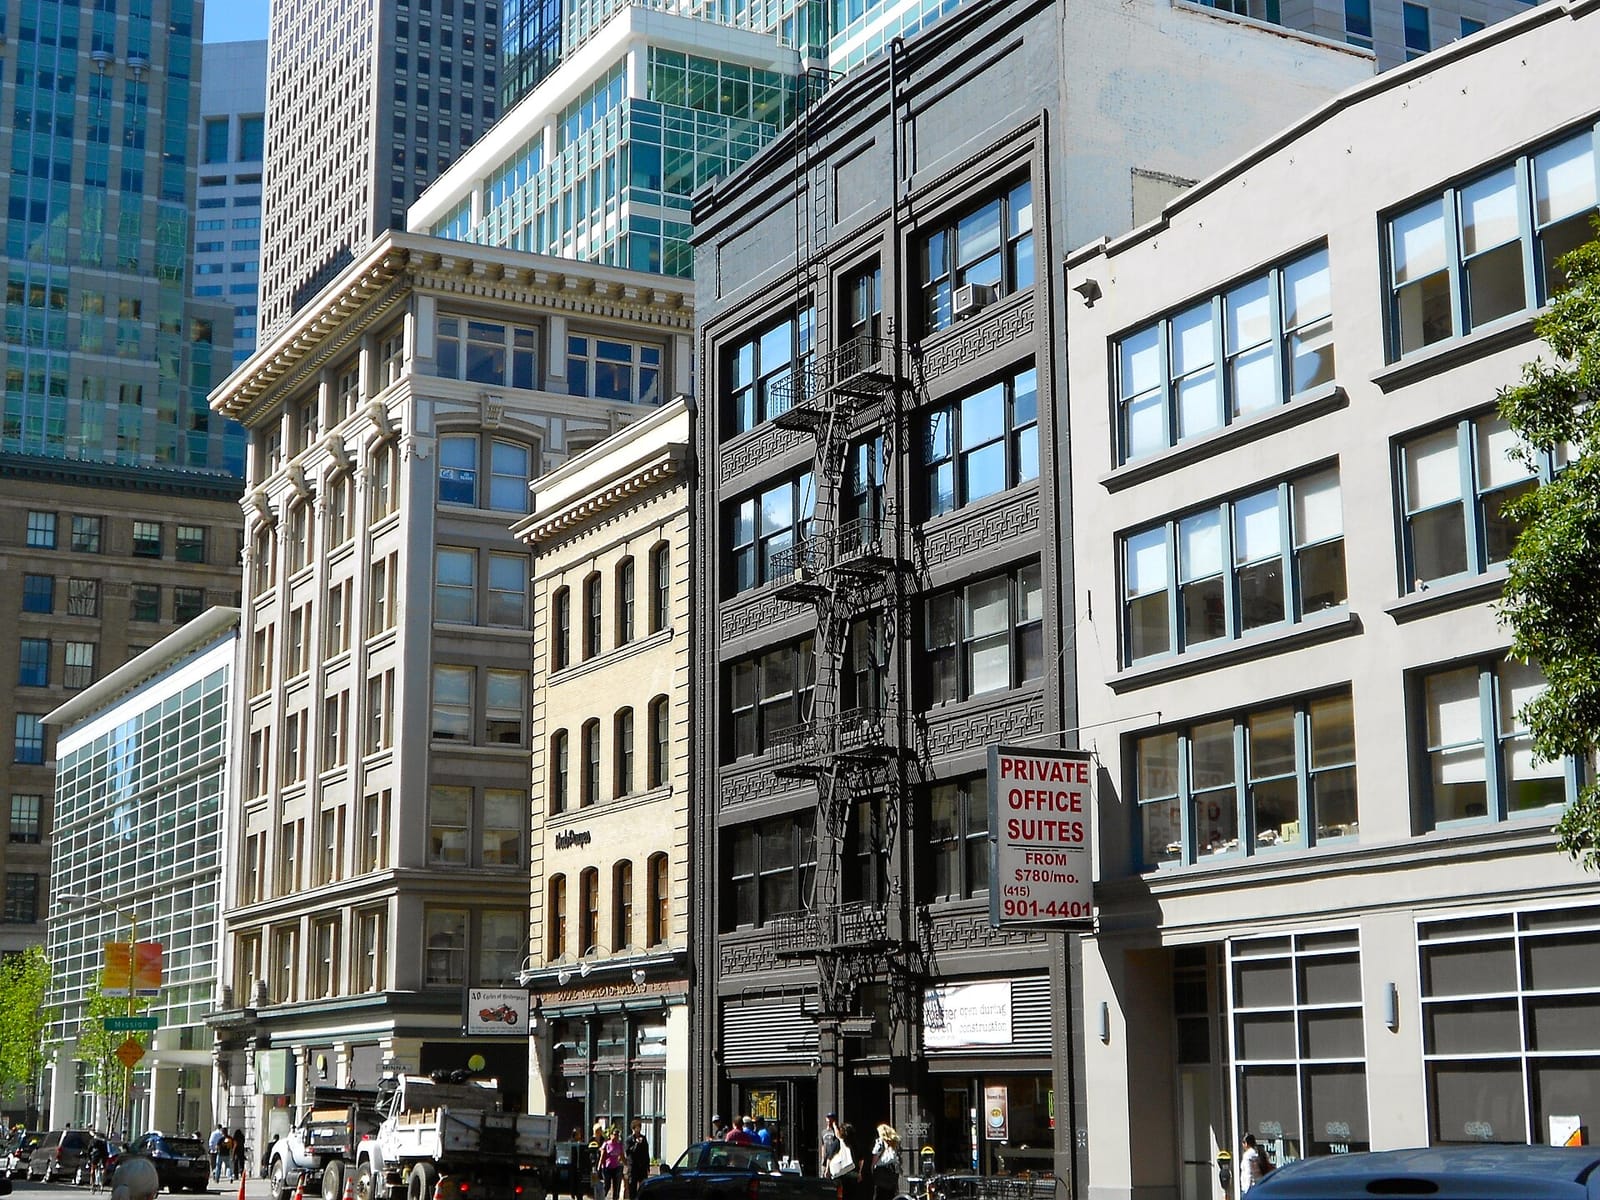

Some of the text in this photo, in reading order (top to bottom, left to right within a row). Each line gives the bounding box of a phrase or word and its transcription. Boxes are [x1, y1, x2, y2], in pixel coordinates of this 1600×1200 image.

[1001, 758, 1088, 784] PRIVATE
[1008, 788, 1082, 813] OFFICE
[1007, 818, 1084, 843] SUITES
[1025, 852, 1067, 866] FROM
[1015, 868, 1079, 884] $780/mo.
[1003, 884, 1030, 897] (415)
[1004, 899, 1092, 918] 901-4401
[114, 1019, 149, 1028] Mission
[1329, 1143, 1349, 1153] THAI
